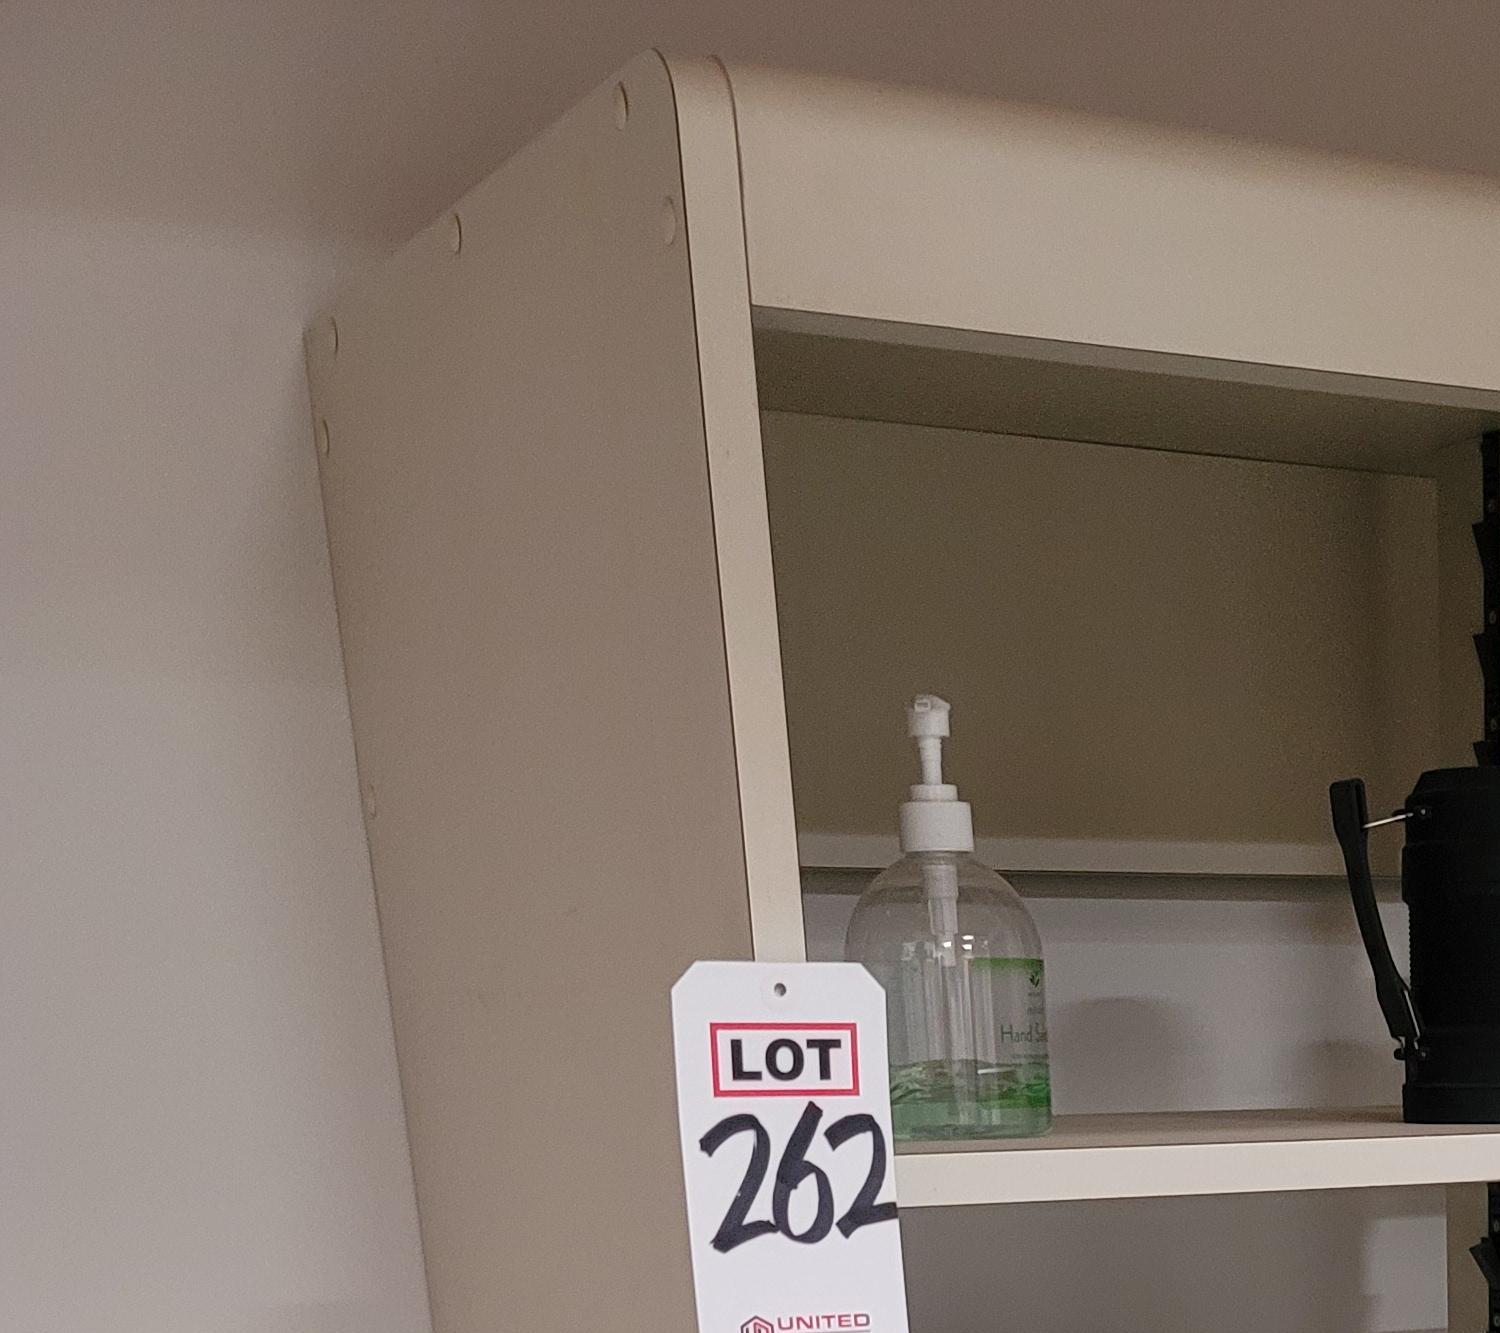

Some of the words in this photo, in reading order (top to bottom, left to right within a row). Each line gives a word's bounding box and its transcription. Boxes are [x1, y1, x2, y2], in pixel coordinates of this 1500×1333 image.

[1001, 1024, 1032, 1042] Hand
[730, 1038, 842, 1081] LOT
[700, 1101, 899, 1253] 262
[777, 1313, 871, 1330] UNITED
